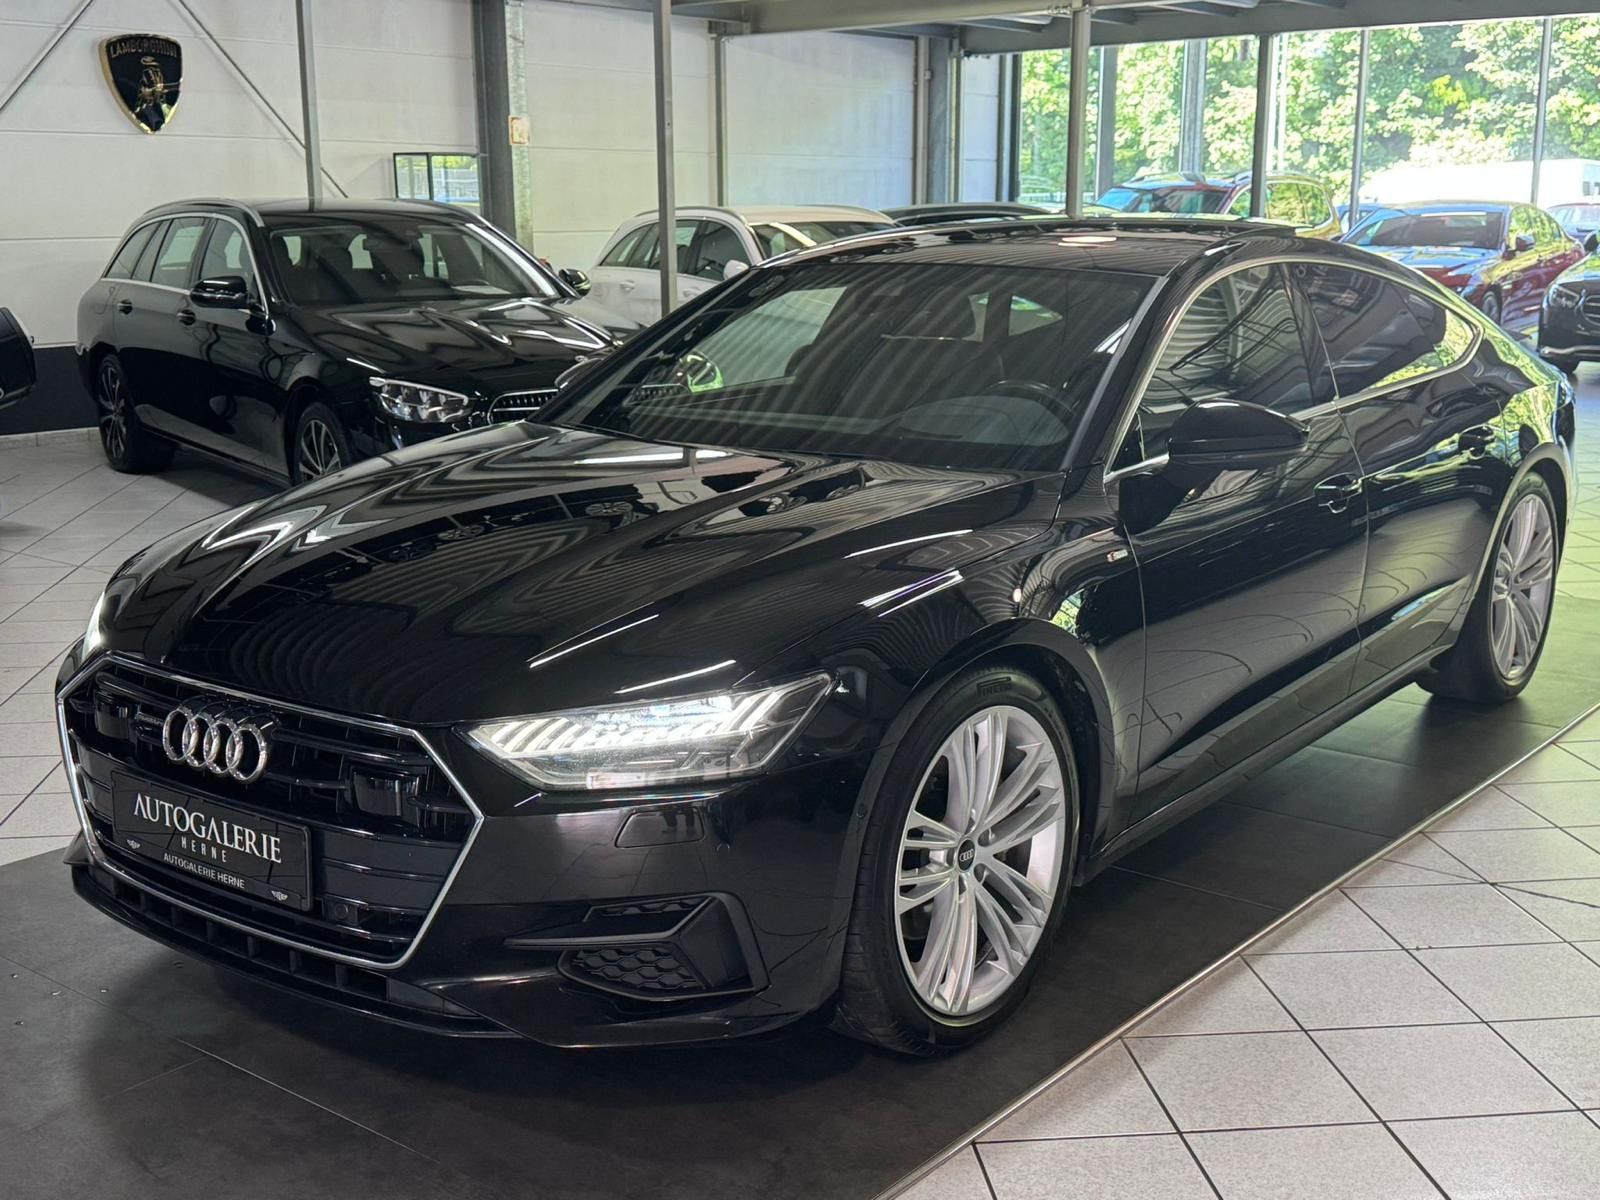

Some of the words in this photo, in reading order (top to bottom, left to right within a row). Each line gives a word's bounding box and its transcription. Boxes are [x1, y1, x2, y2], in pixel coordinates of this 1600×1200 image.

[134, 792, 282, 863] AUTOGALERIE
[181, 836, 227, 863] HERNE
[163, 852, 216, 881] AUTOGALERIE
[217, 869, 245, 889] HERNE
